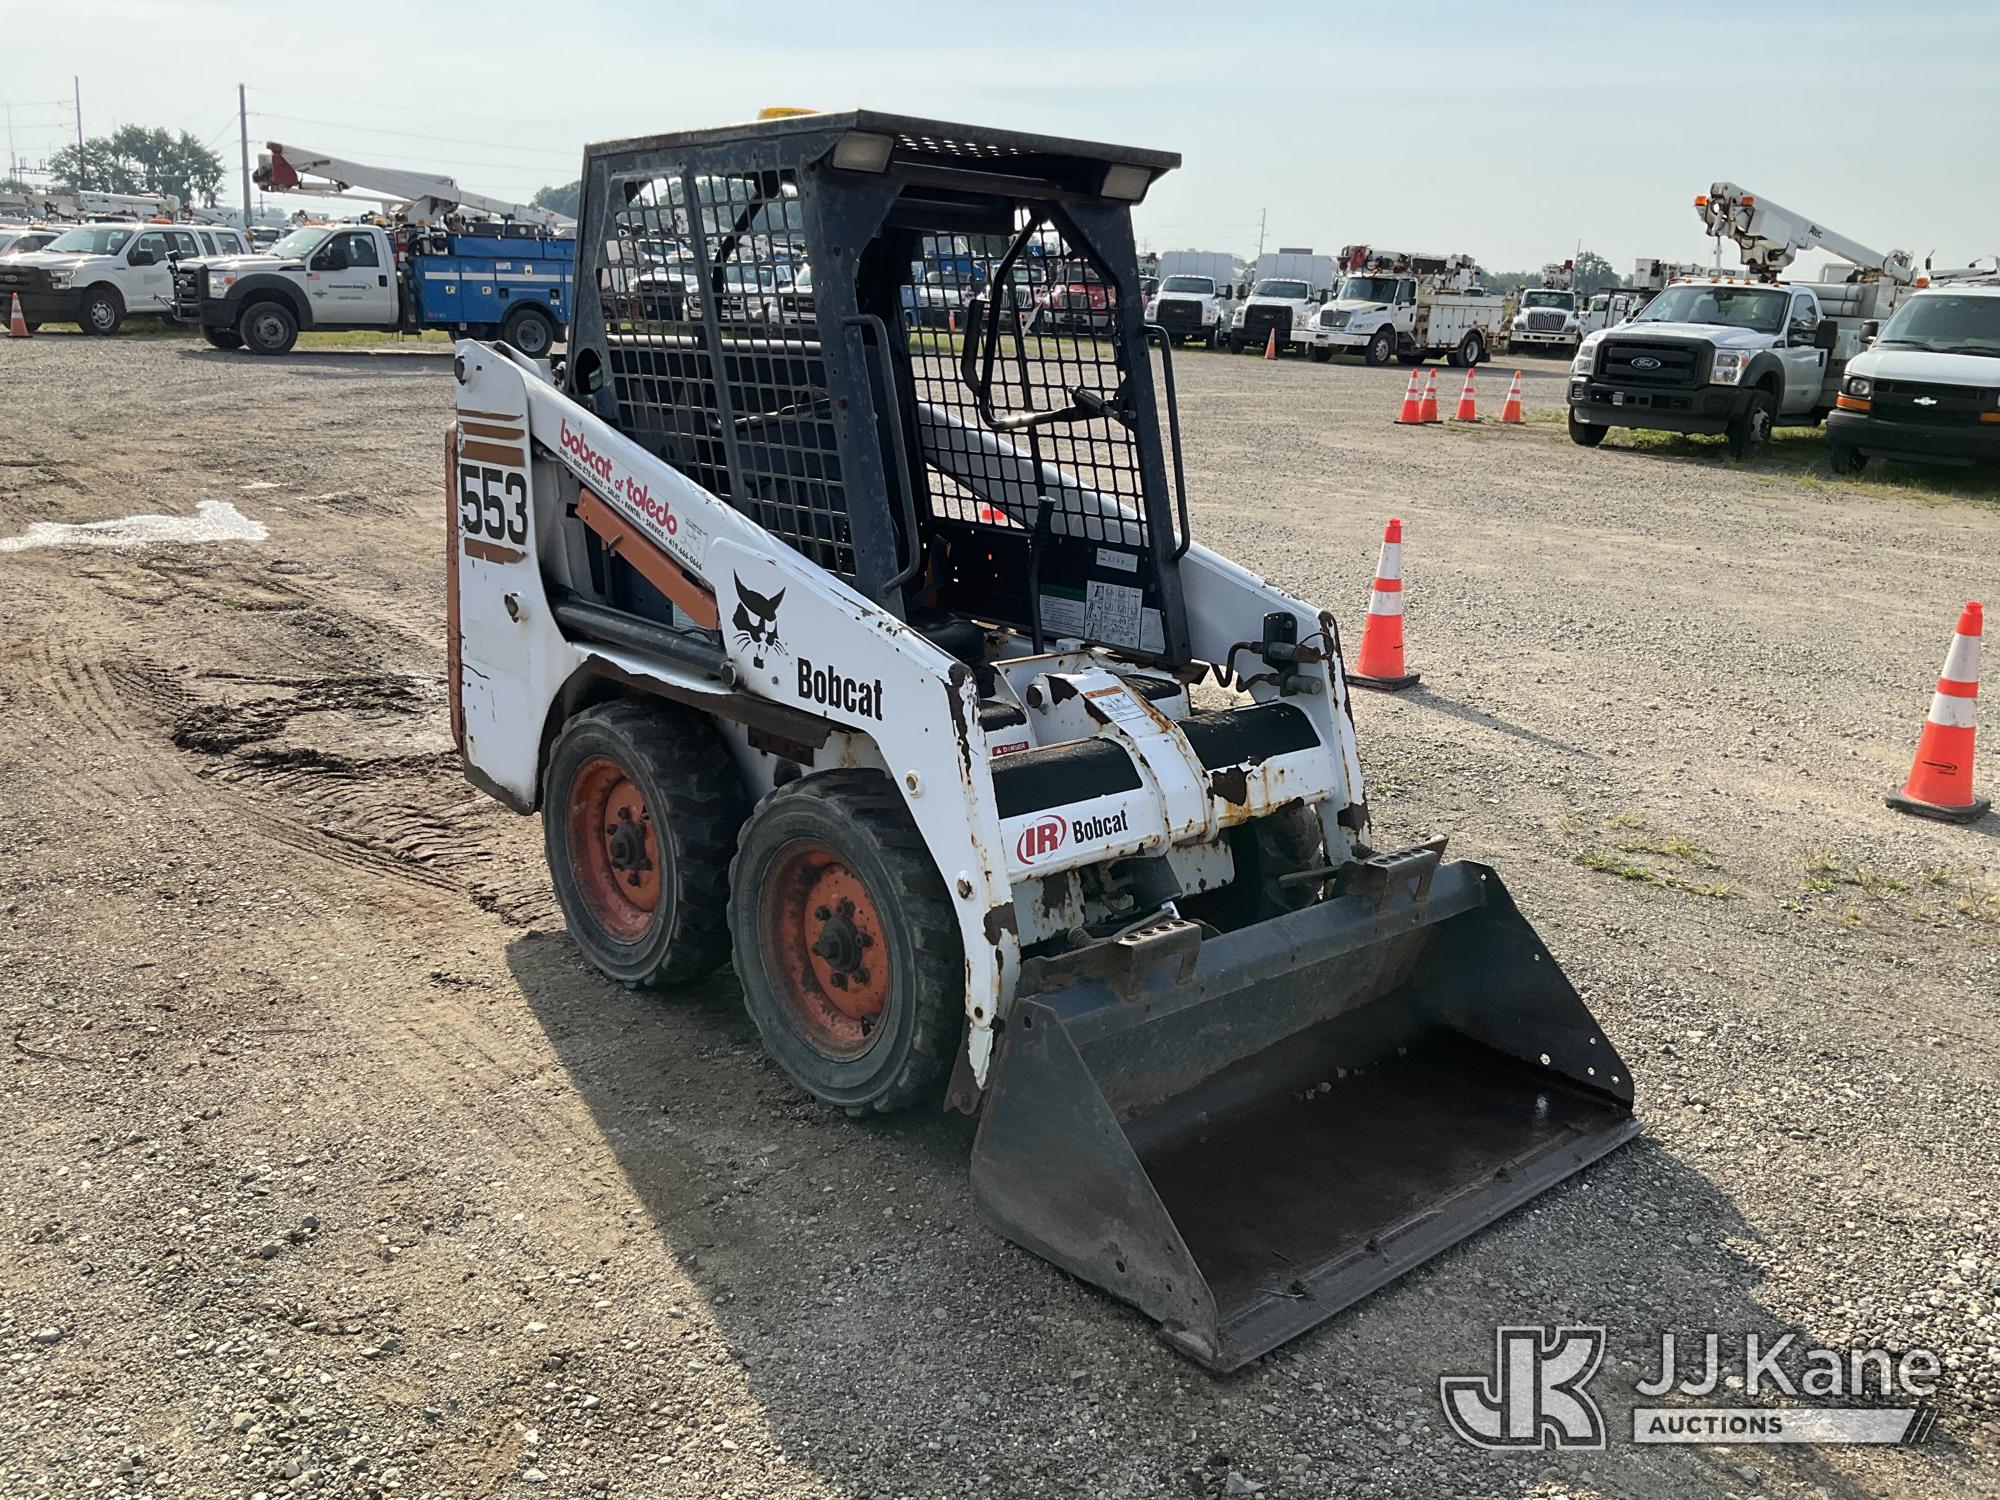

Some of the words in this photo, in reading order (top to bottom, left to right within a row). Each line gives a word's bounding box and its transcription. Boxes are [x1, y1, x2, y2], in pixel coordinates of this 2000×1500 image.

[460, 463, 528, 545] 553
[561, 418, 612, 483] bobcat
[626, 476, 678, 535] toledo
[646, 519, 664, 539] SERVICE
[797, 657, 882, 721] Bobcat
[1026, 823, 1058, 857] IR
[1072, 810, 1128, 844] Bobcat
